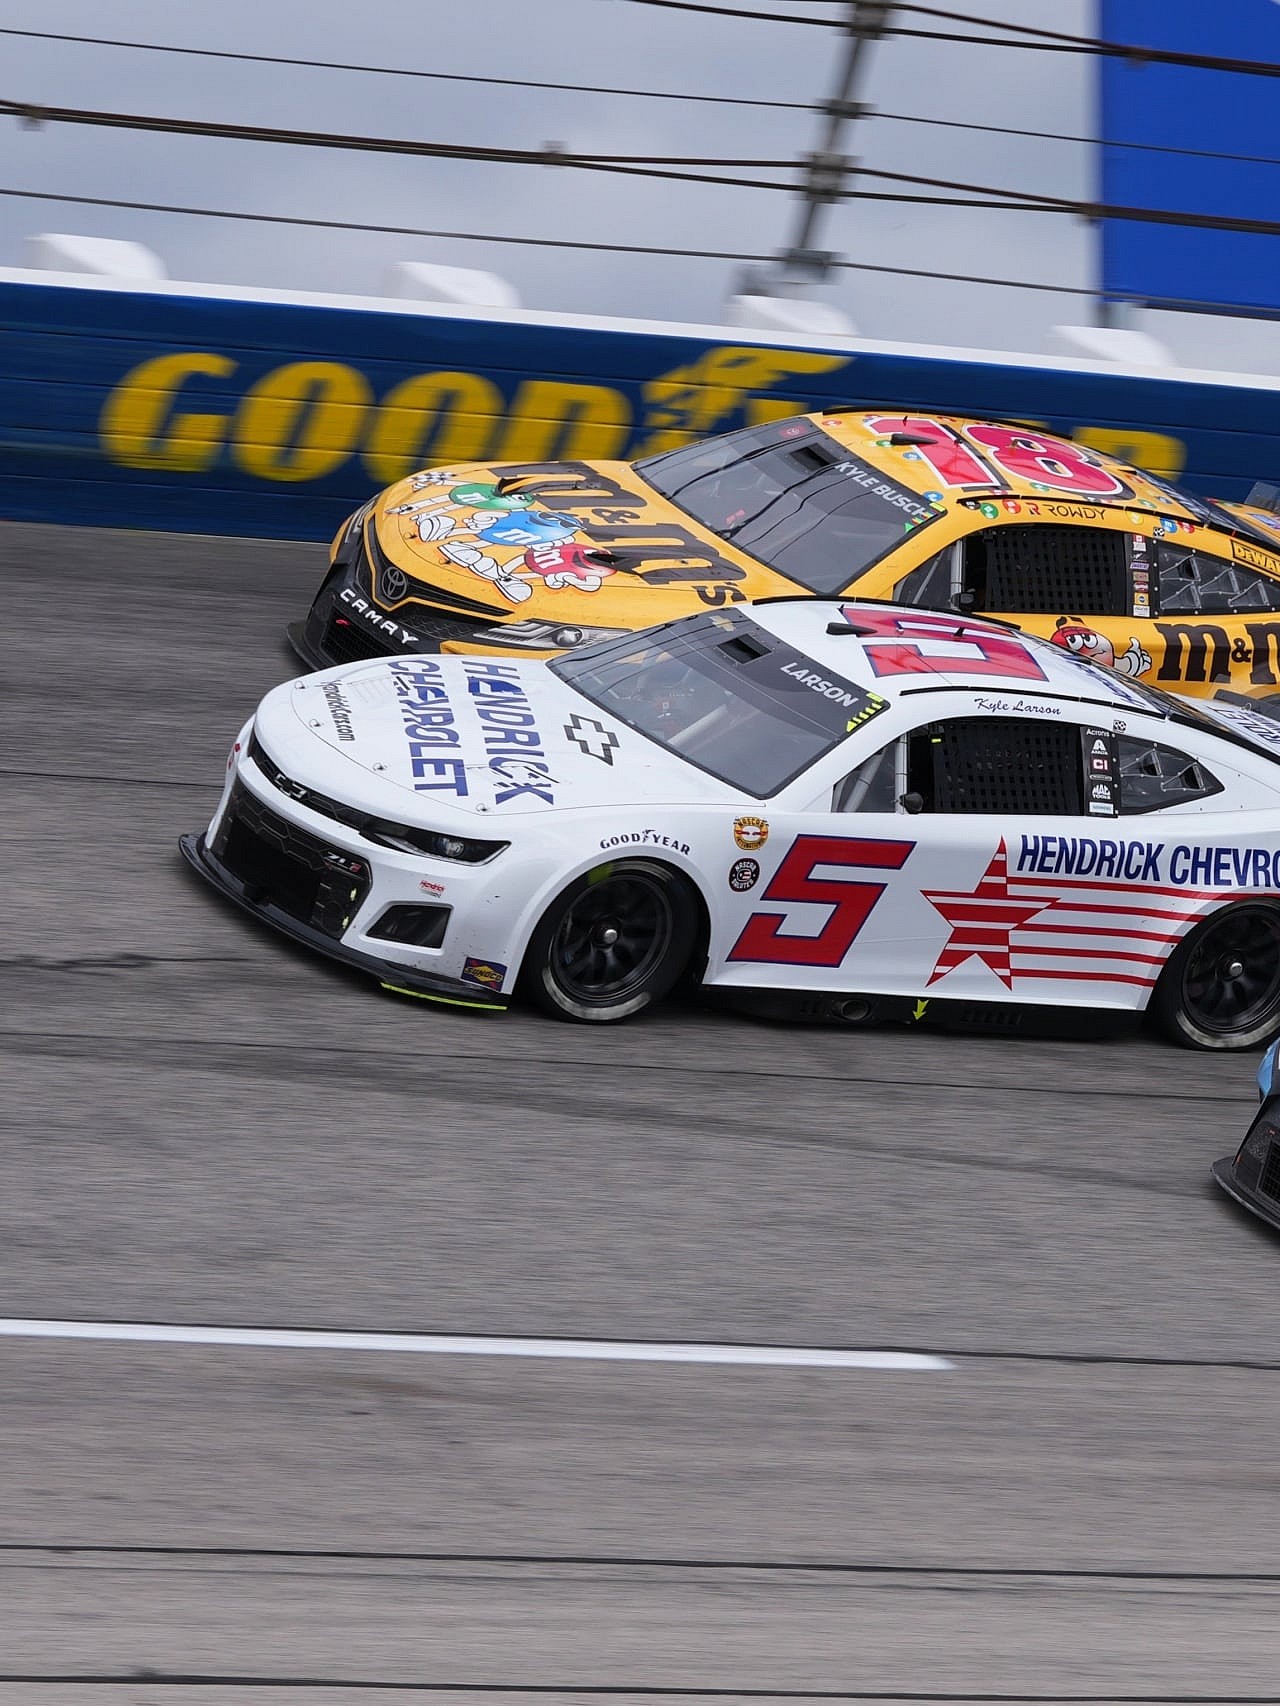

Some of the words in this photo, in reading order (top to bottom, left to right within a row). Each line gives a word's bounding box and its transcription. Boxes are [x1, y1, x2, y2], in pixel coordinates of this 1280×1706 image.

[834, 462, 880, 487] KYLE
[864, 416, 1124, 495] 18
[1041, 503, 1107, 520] ROWDY
[492, 529, 542, 544] m
[340, 588, 419, 644] CAMRY
[841, 607, 1049, 682] 5
[780, 662, 859, 707] LARSON
[974, 698, 1009, 713] Kyle
[1012, 700, 1061, 715] Larson
[387, 660, 469, 797] CHEVROLET
[462, 660, 554, 805] HENDRICK
[600, 829, 690, 855] GOODYEAR
[1017, 835, 1164, 882] HENDRICK
[725, 833, 917, 969] 5
[464, 968, 503, 982] SUNOCO
